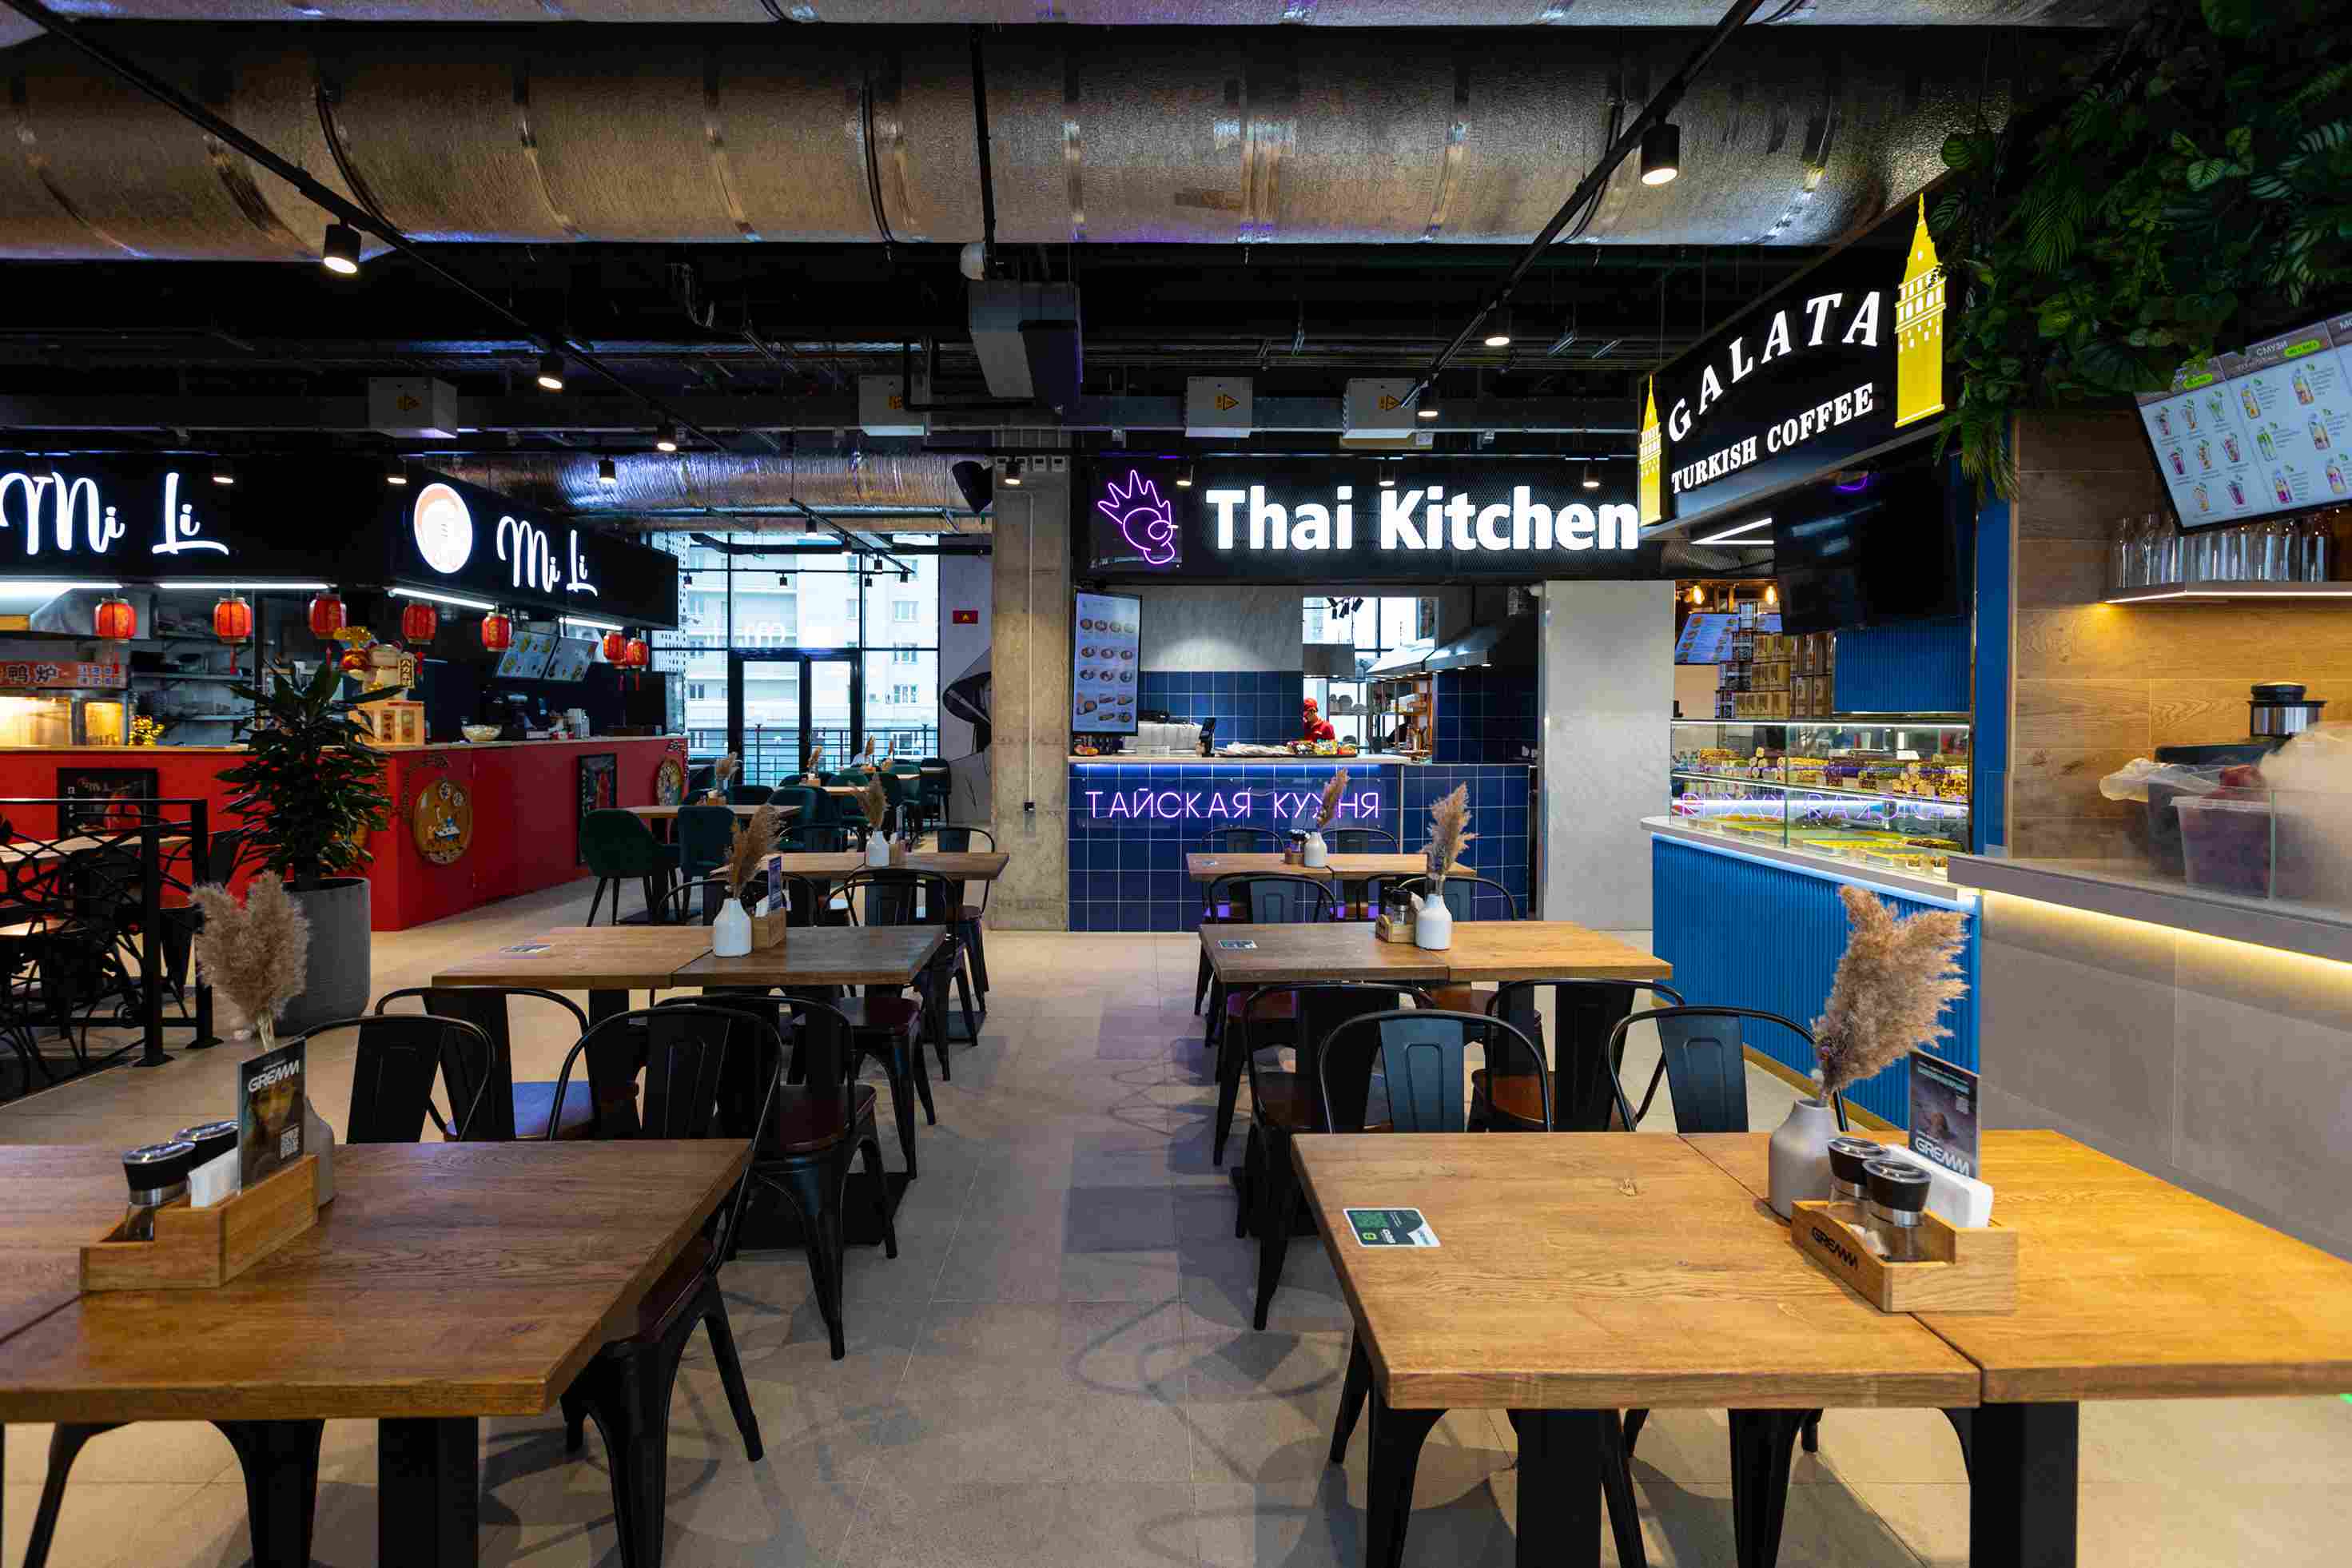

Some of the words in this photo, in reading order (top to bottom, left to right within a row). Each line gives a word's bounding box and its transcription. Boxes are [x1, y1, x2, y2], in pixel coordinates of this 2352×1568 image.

[1669, 291, 1880, 441] GALATA
[1671, 436, 1757, 494] TURKISH
[1767, 382, 1873, 452] COFFEE
[0, 472, 125, 555] Mi
[151, 472, 229, 555] Li
[1206, 486, 1353, 551] Thai
[1380, 486, 1639, 551] Kitchen
[496, 515, 560, 593] Mi
[566, 529, 599, 597] Li
[1085, 788, 1251, 818] ТАЙСКАЯ
